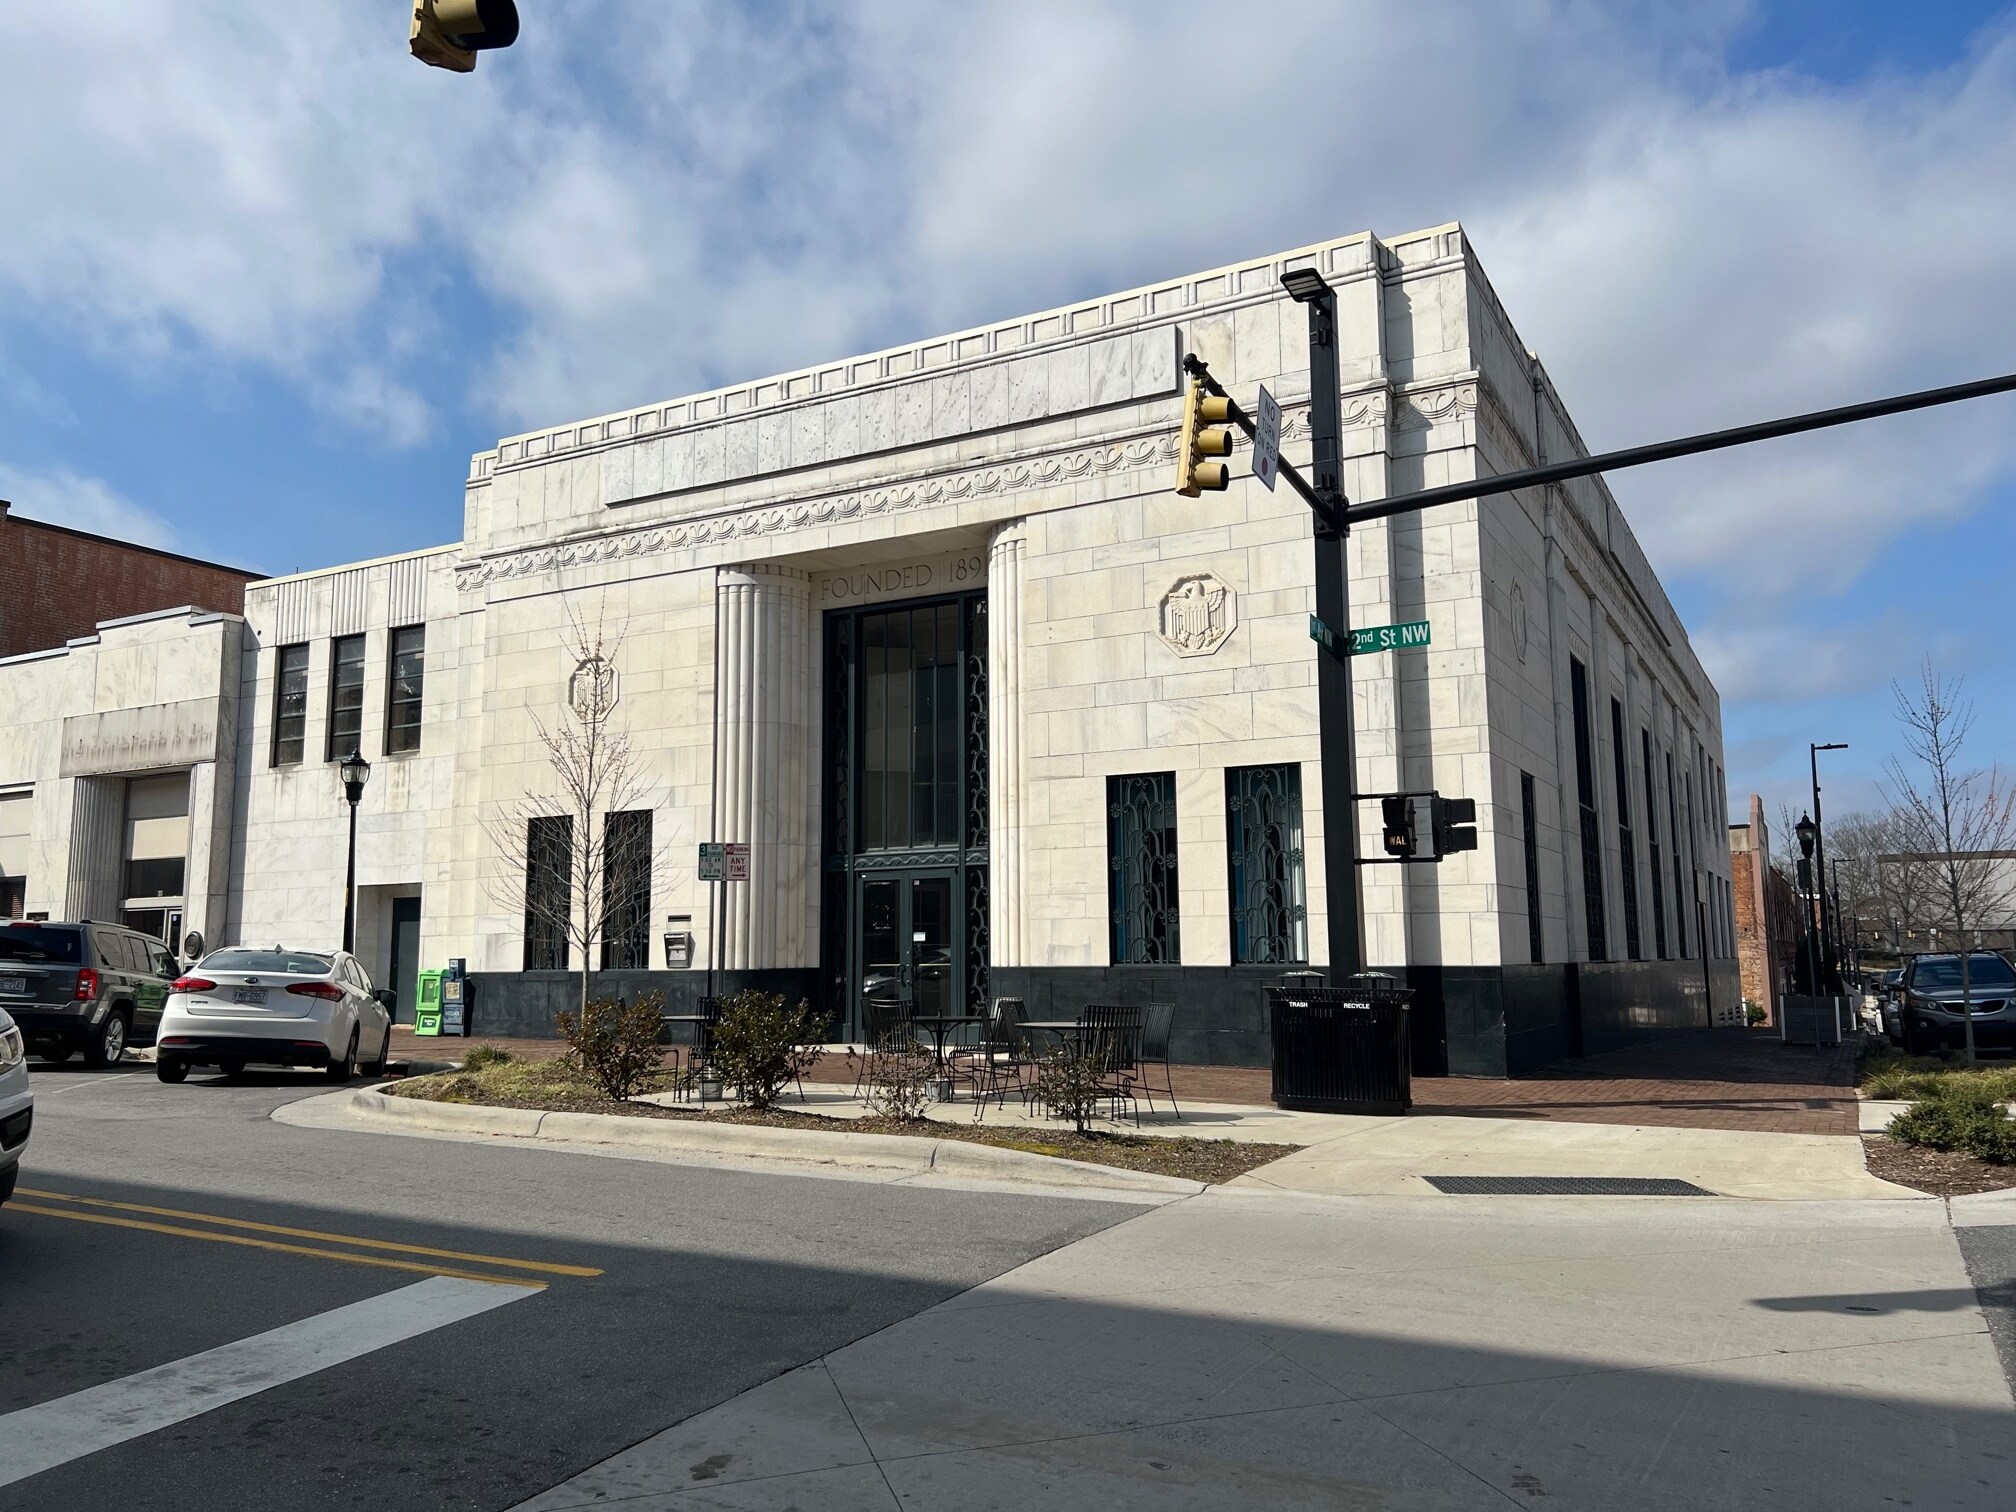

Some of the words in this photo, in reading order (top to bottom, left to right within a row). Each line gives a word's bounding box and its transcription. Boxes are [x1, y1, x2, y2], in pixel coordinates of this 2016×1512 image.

[1265, 398, 1275, 421] NO
[1262, 417, 1275, 443] TURN
[1257, 432, 1265, 450] ON
[1266, 442, 1277, 462] RED
[821, 564, 932, 601] FOUNDED
[1351, 631, 1374, 650] 2nd
[1379, 629, 1396, 647] St
[1402, 624, 1429, 644] NW
[700, 845, 706, 855] 3
[726, 845, 734, 853] NO
